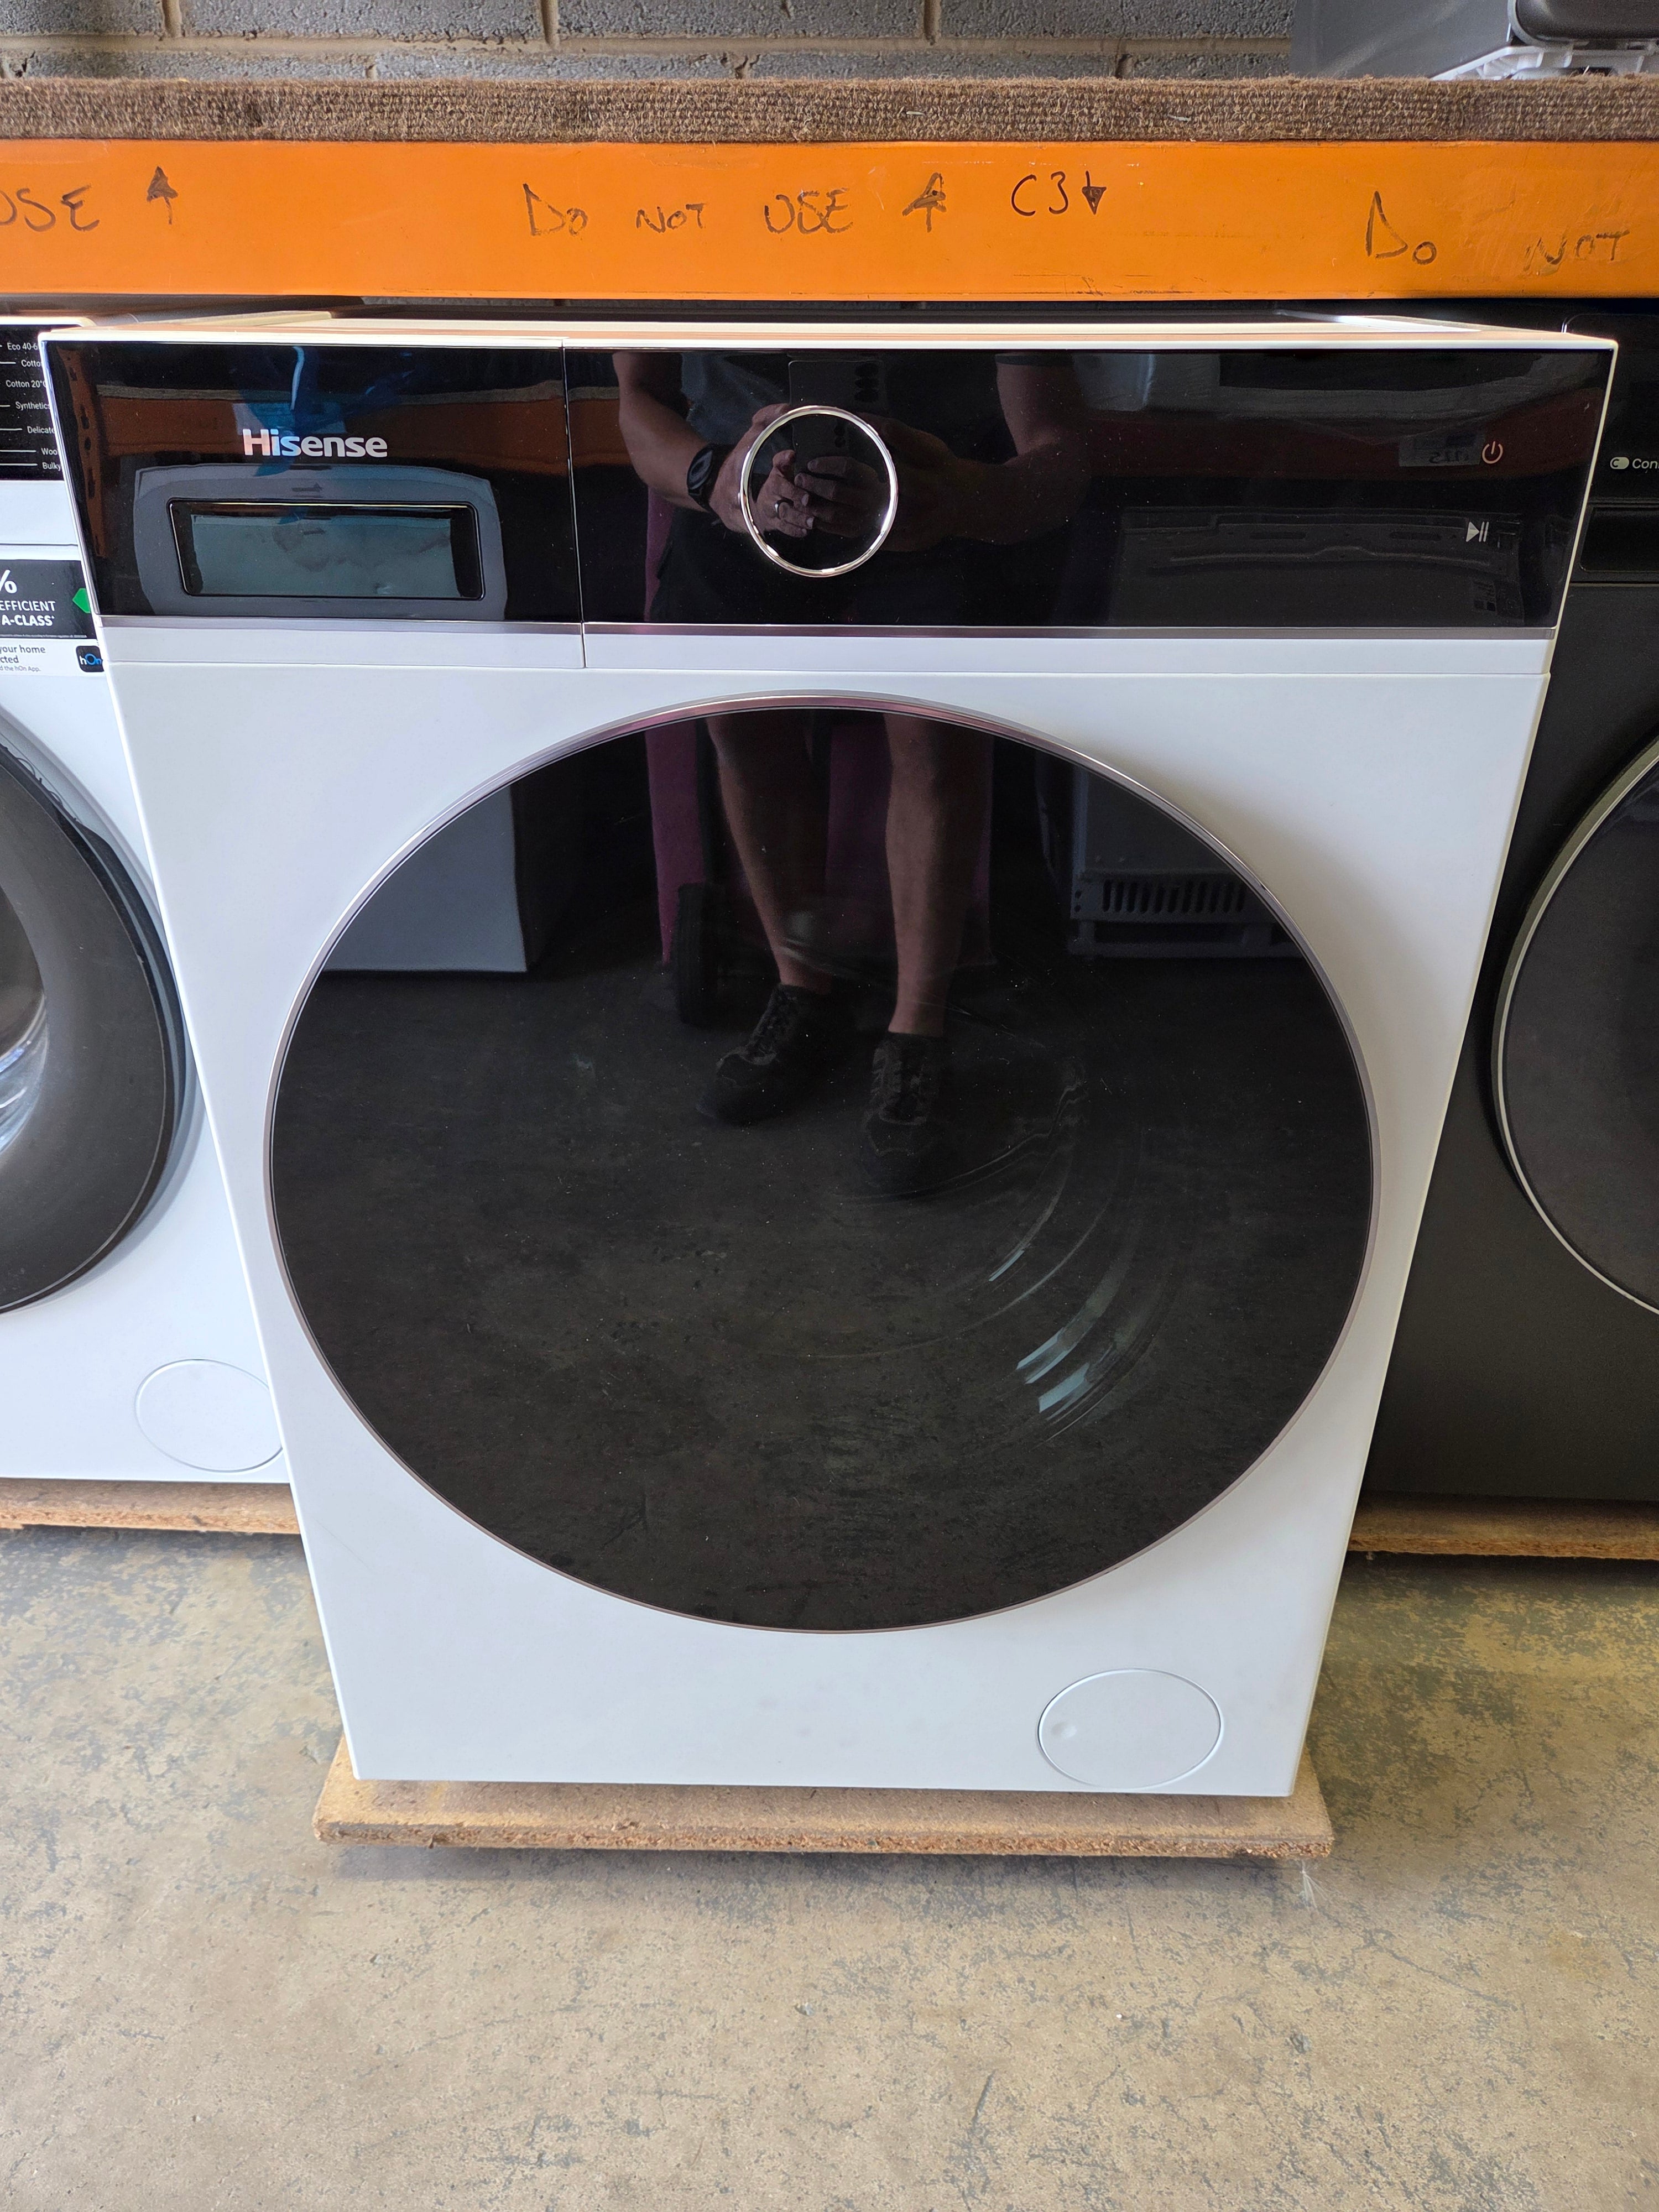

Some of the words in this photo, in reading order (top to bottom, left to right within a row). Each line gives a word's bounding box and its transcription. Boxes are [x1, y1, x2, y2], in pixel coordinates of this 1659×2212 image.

[1011, 171, 1068, 216] C3
[764, 187, 853, 234] USE
[242, 429, 388, 458] Hisense
[42, 462, 61, 471] Bulky
[1632, 458, 1659, 469] Con
[19, 645, 46, 654] home
